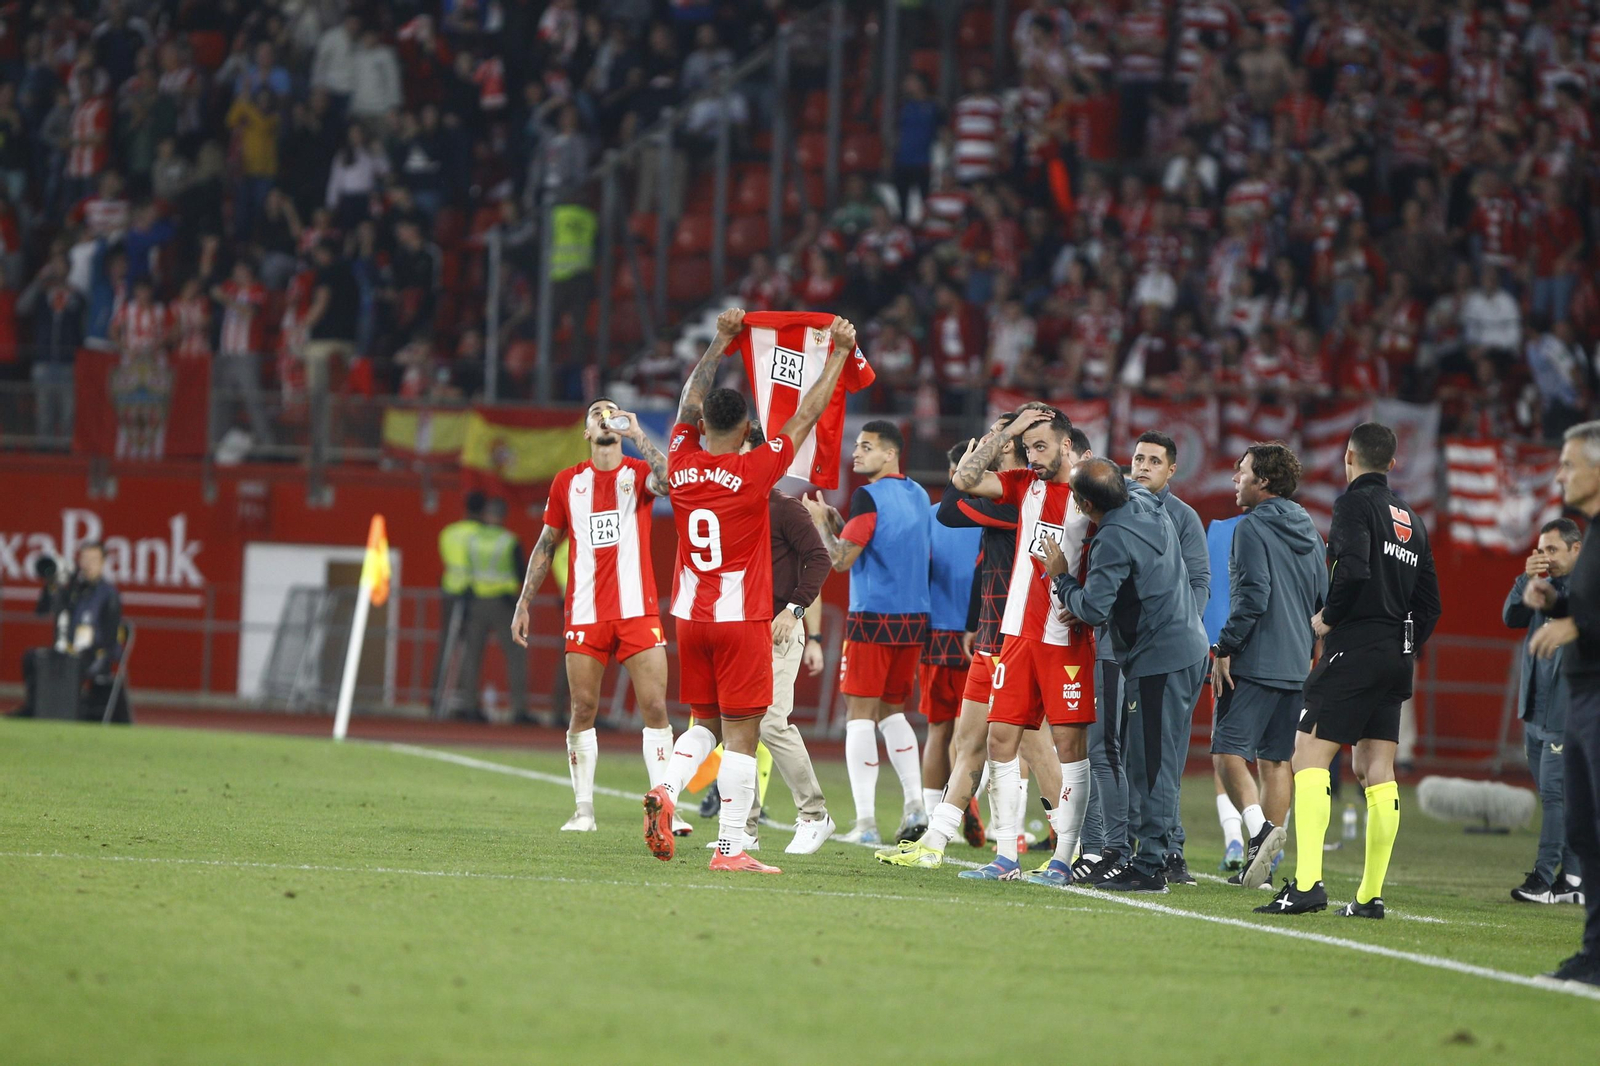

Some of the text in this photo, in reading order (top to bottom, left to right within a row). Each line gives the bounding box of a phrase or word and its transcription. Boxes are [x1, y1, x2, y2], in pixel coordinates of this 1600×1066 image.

[780, 354, 797, 369] DA
[779, 366, 796, 380] ZN
[669, 467, 699, 489] LUIS
[596, 518, 614, 529] DA
[597, 530, 614, 540] ZN
[688, 508, 723, 572] 9
[1062, 690, 1081, 699] KUDU
